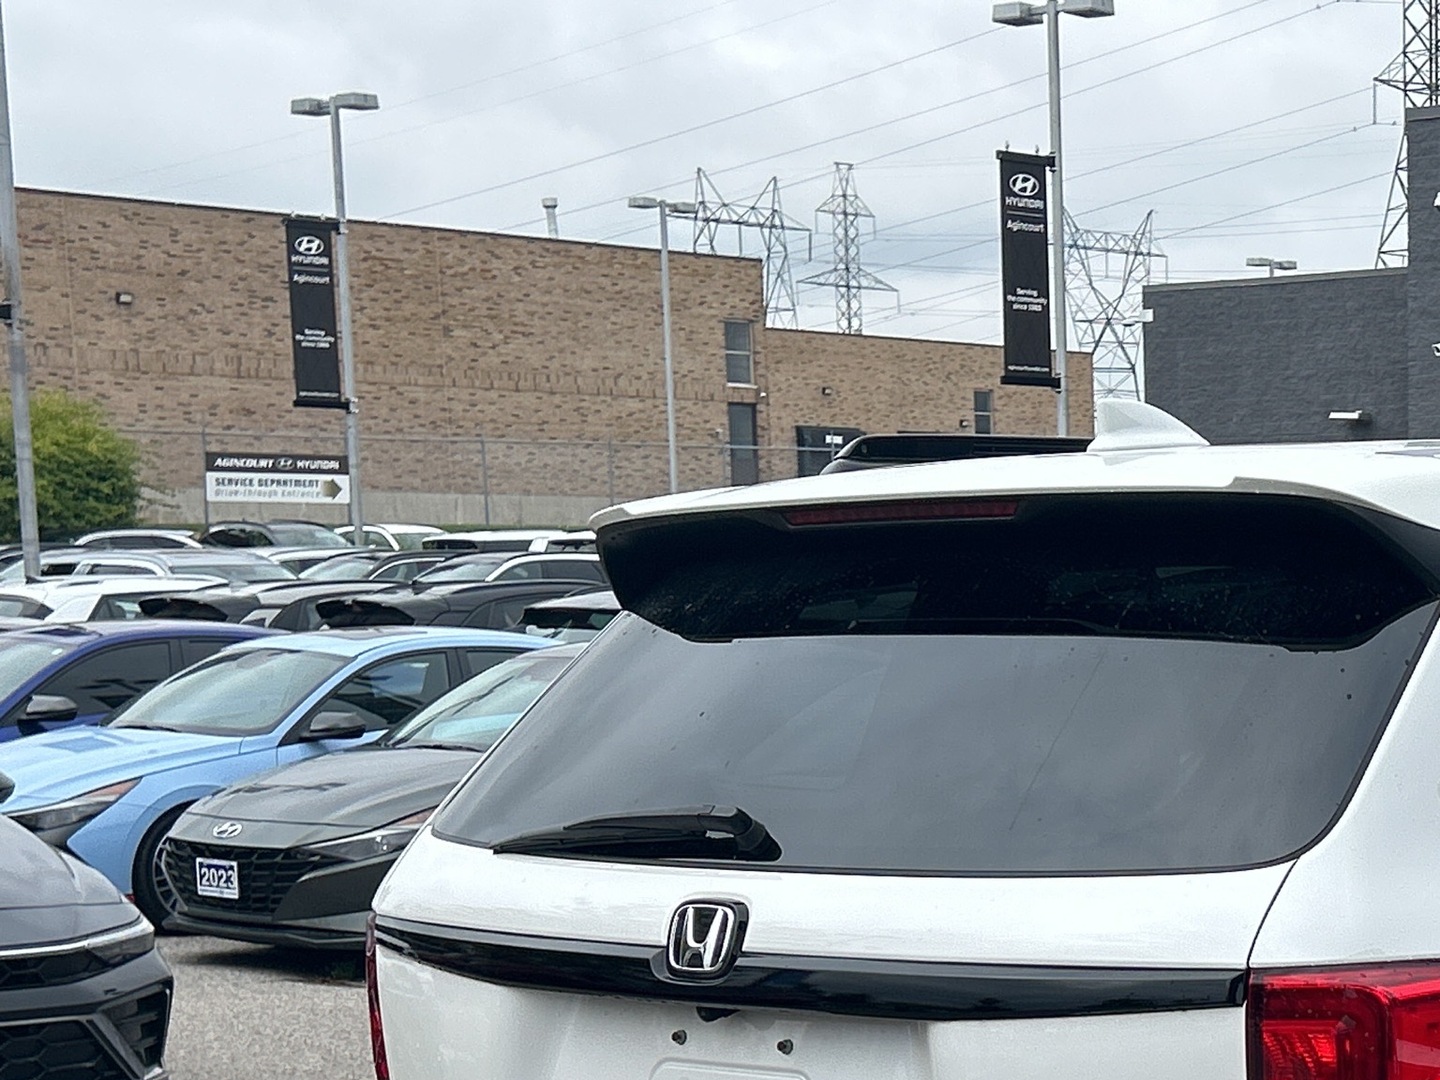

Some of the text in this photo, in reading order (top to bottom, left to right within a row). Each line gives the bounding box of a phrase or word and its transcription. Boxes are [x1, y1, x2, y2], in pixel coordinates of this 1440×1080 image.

[1005, 196, 1044, 209] HYUNDAI
[1006, 219, 1045, 233] Agincourt
[214, 457, 340, 470] AGINCOURT HYUNDAI
[214, 477, 320, 489] SERVICE DEPARTMENT
[201, 867, 235, 888] 2023
